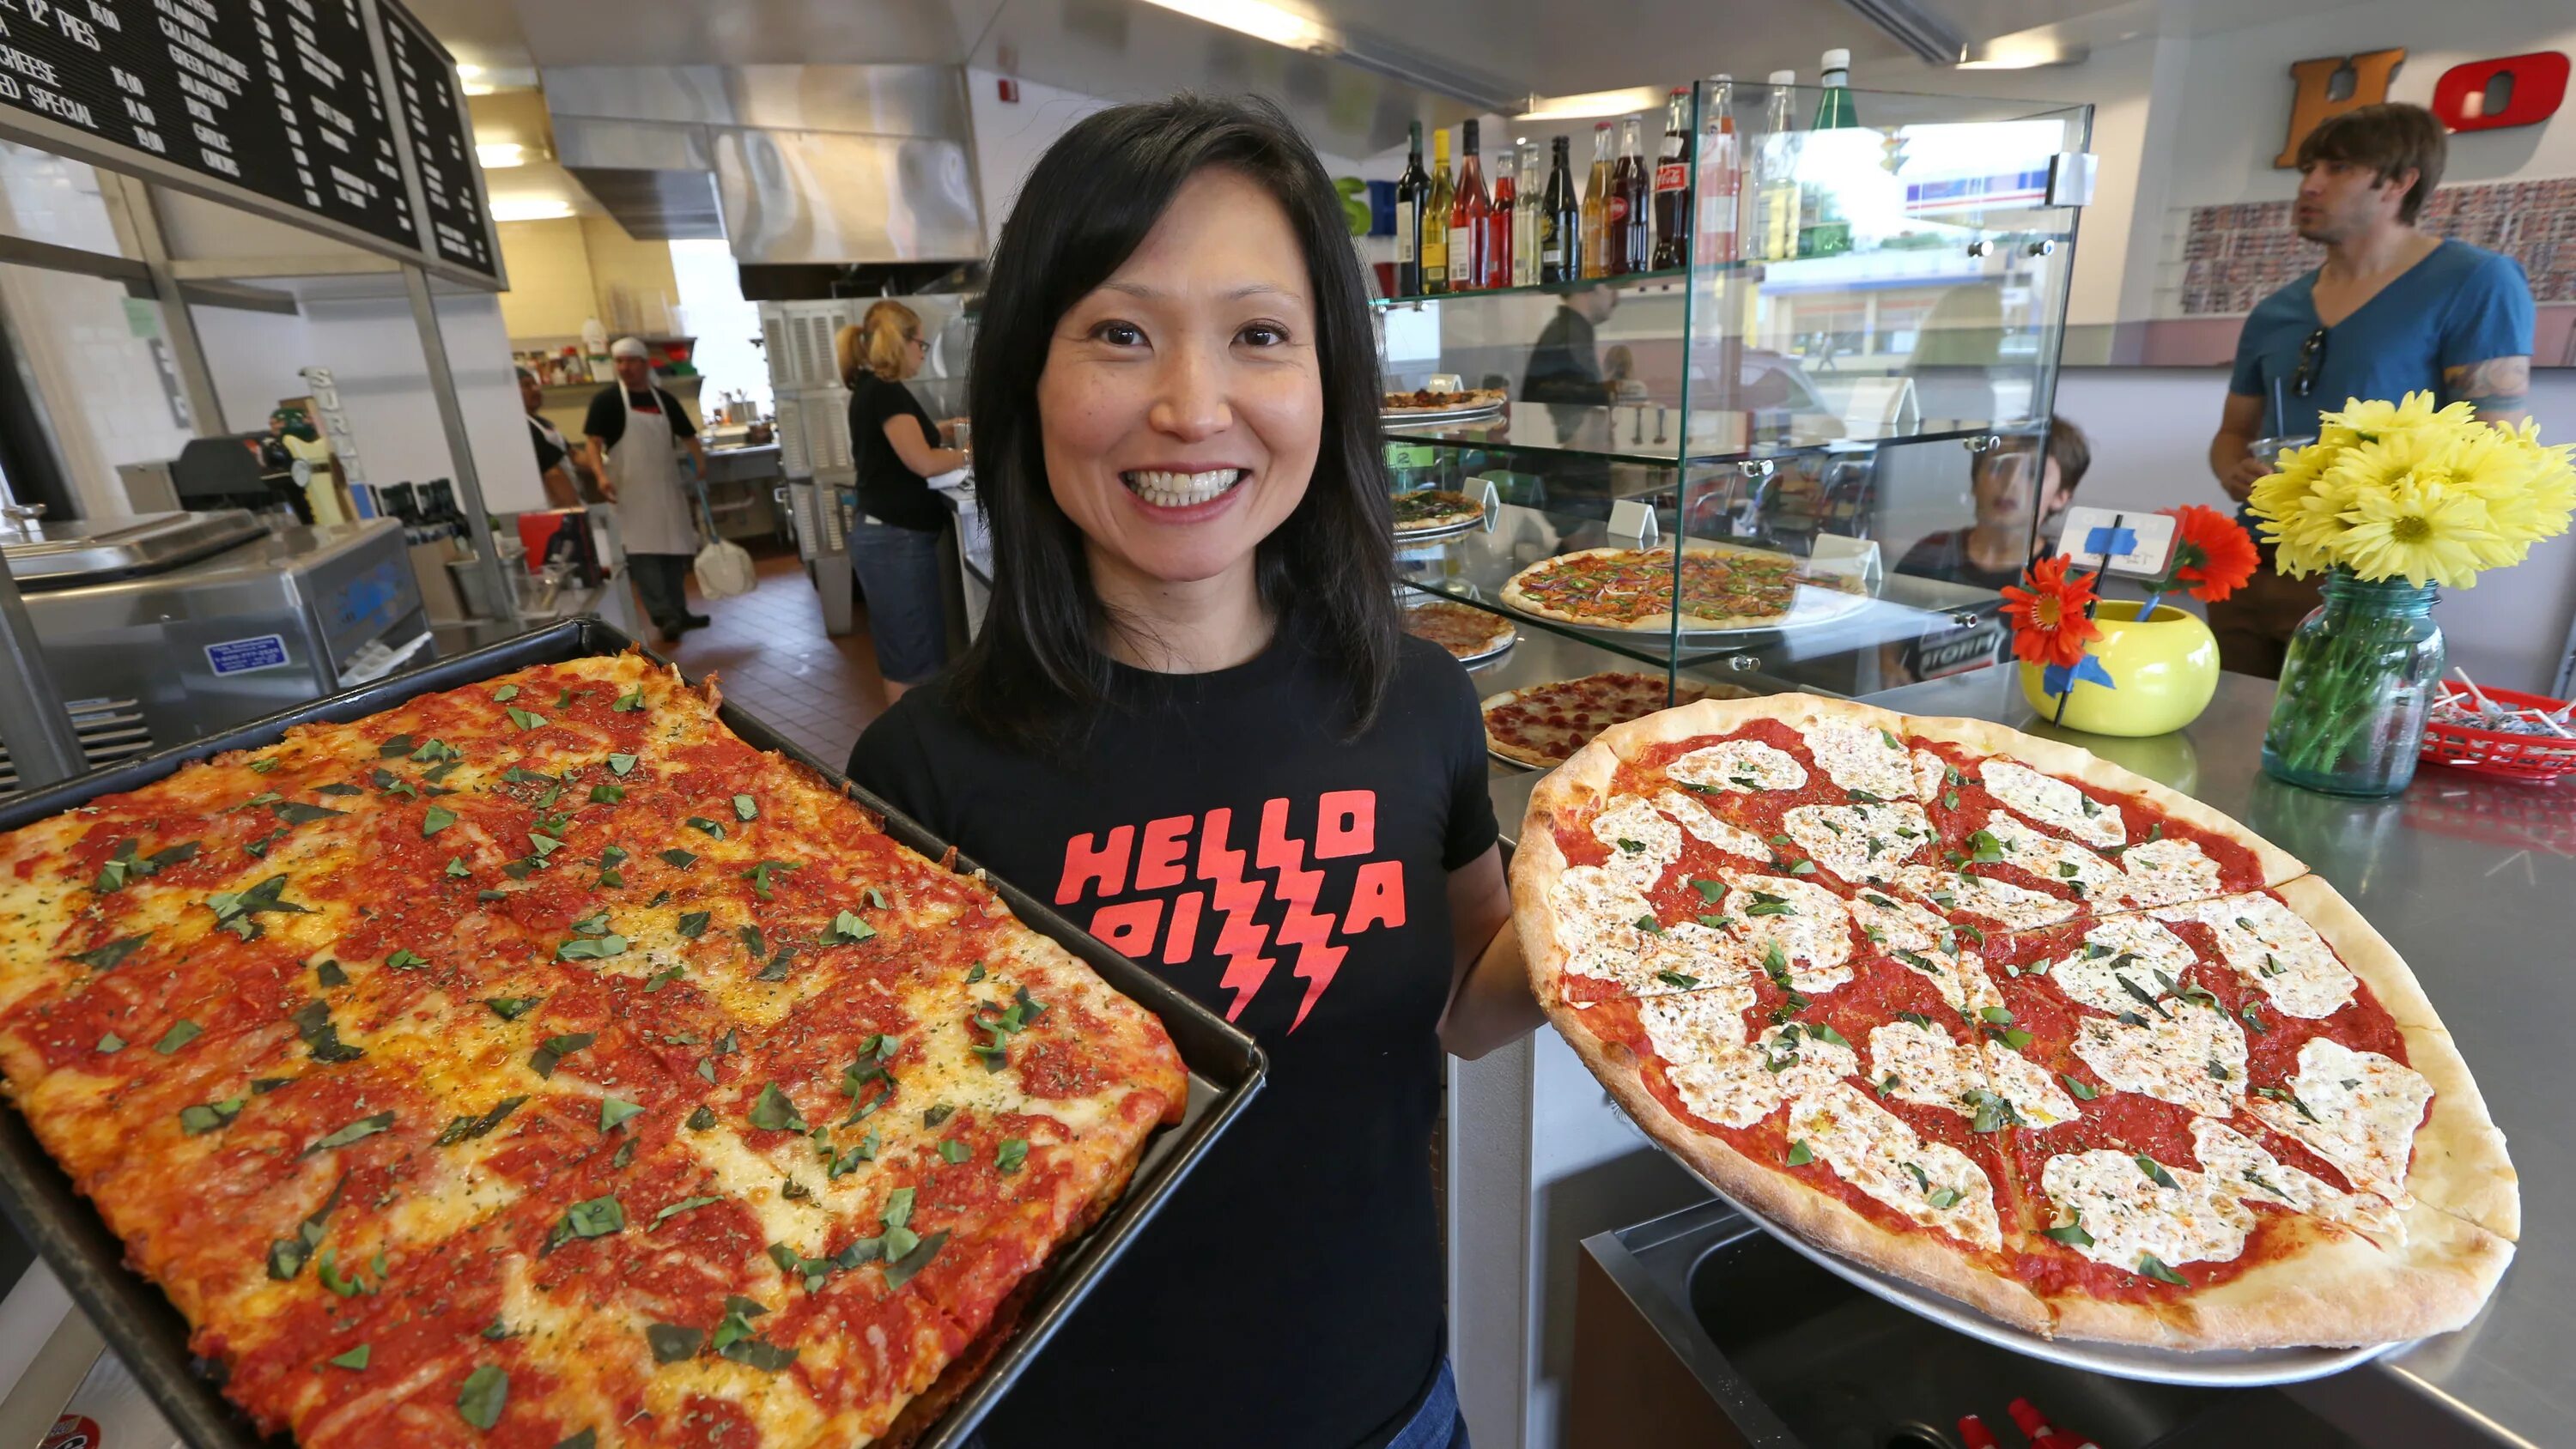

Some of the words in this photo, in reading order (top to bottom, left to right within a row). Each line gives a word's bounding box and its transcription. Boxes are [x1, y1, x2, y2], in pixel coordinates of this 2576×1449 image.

[55, 8, 101, 52] PIES
[0, 44, 62, 88] CHEESE
[27, 83, 100, 129] SPECIAL
[1054, 790, 1376, 906] HELLO
[1089, 860, 1406, 1037] PIZZA
